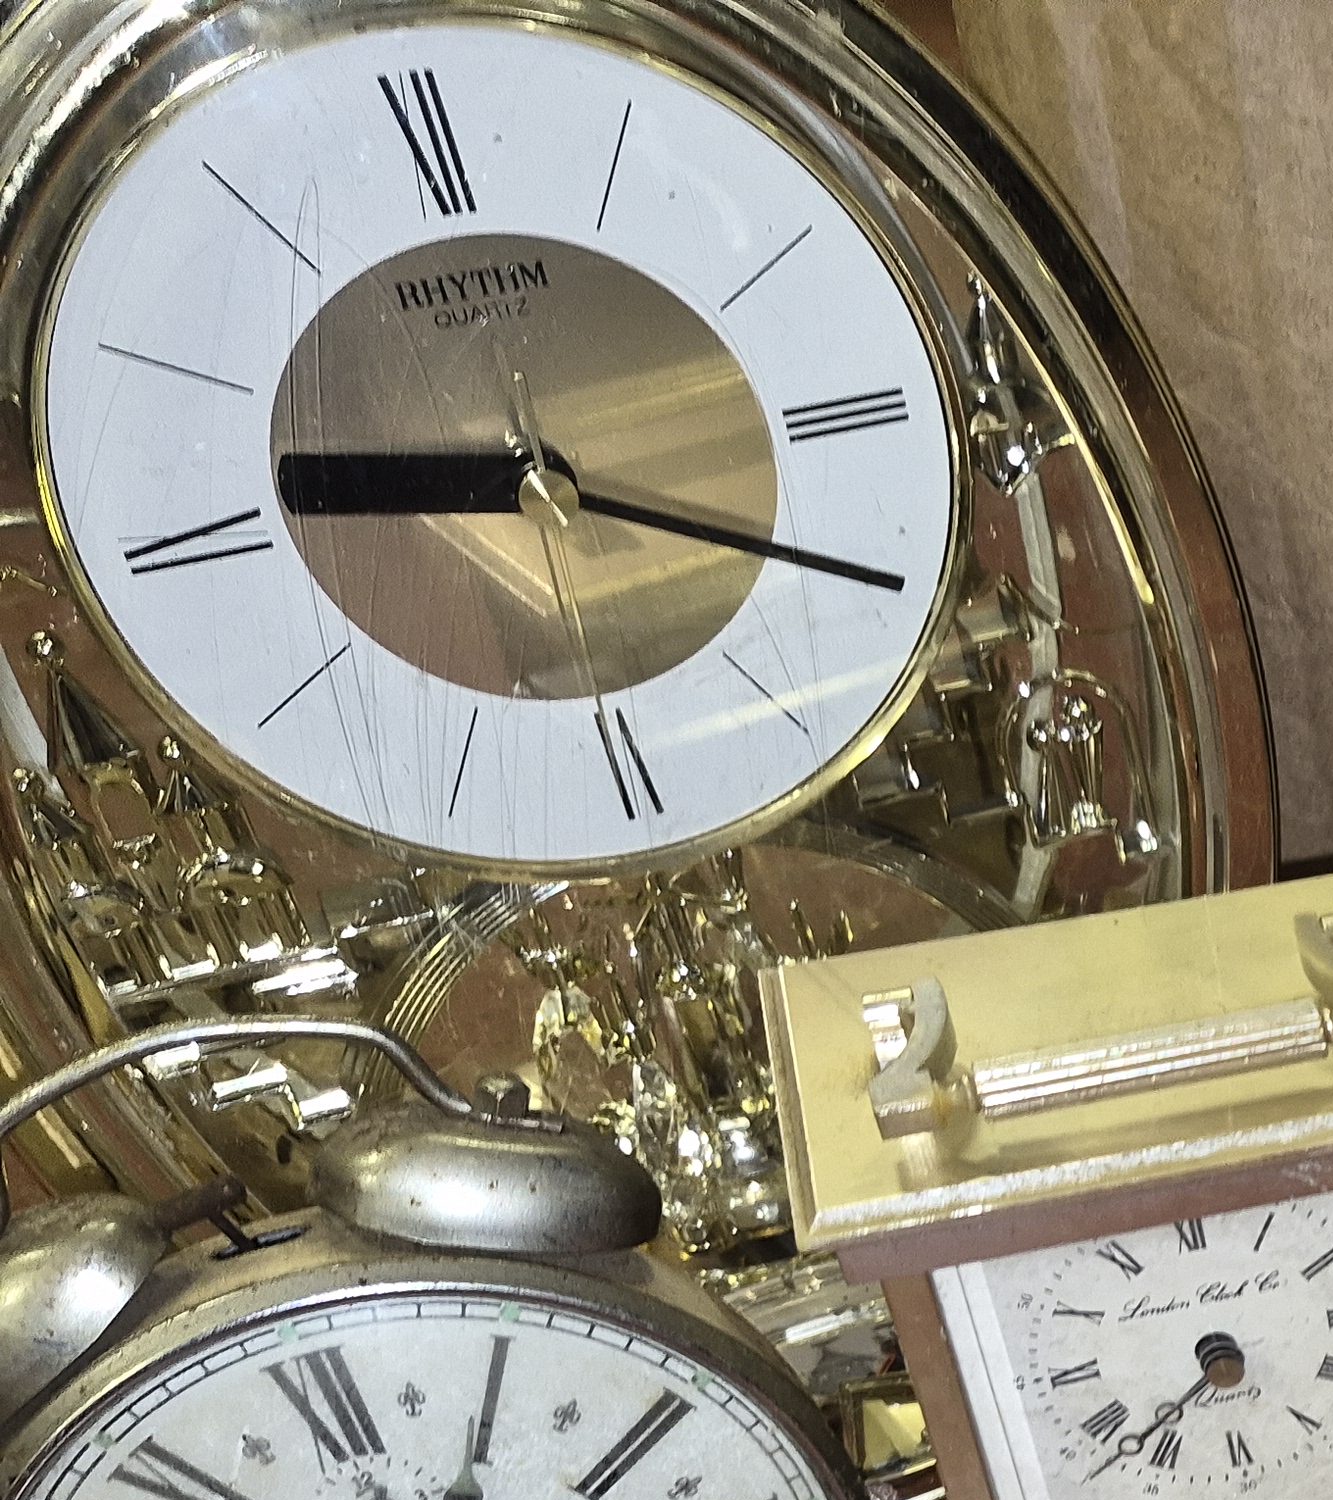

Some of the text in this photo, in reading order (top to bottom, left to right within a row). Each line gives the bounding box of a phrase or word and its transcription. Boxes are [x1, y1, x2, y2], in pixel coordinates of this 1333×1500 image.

[395, 259, 550, 312] RHYTHM
[434, 295, 531, 330] QUARTZ
[1118, 1295, 1190, 1323] London
[1196, 1280, 1249, 1304] Clock
